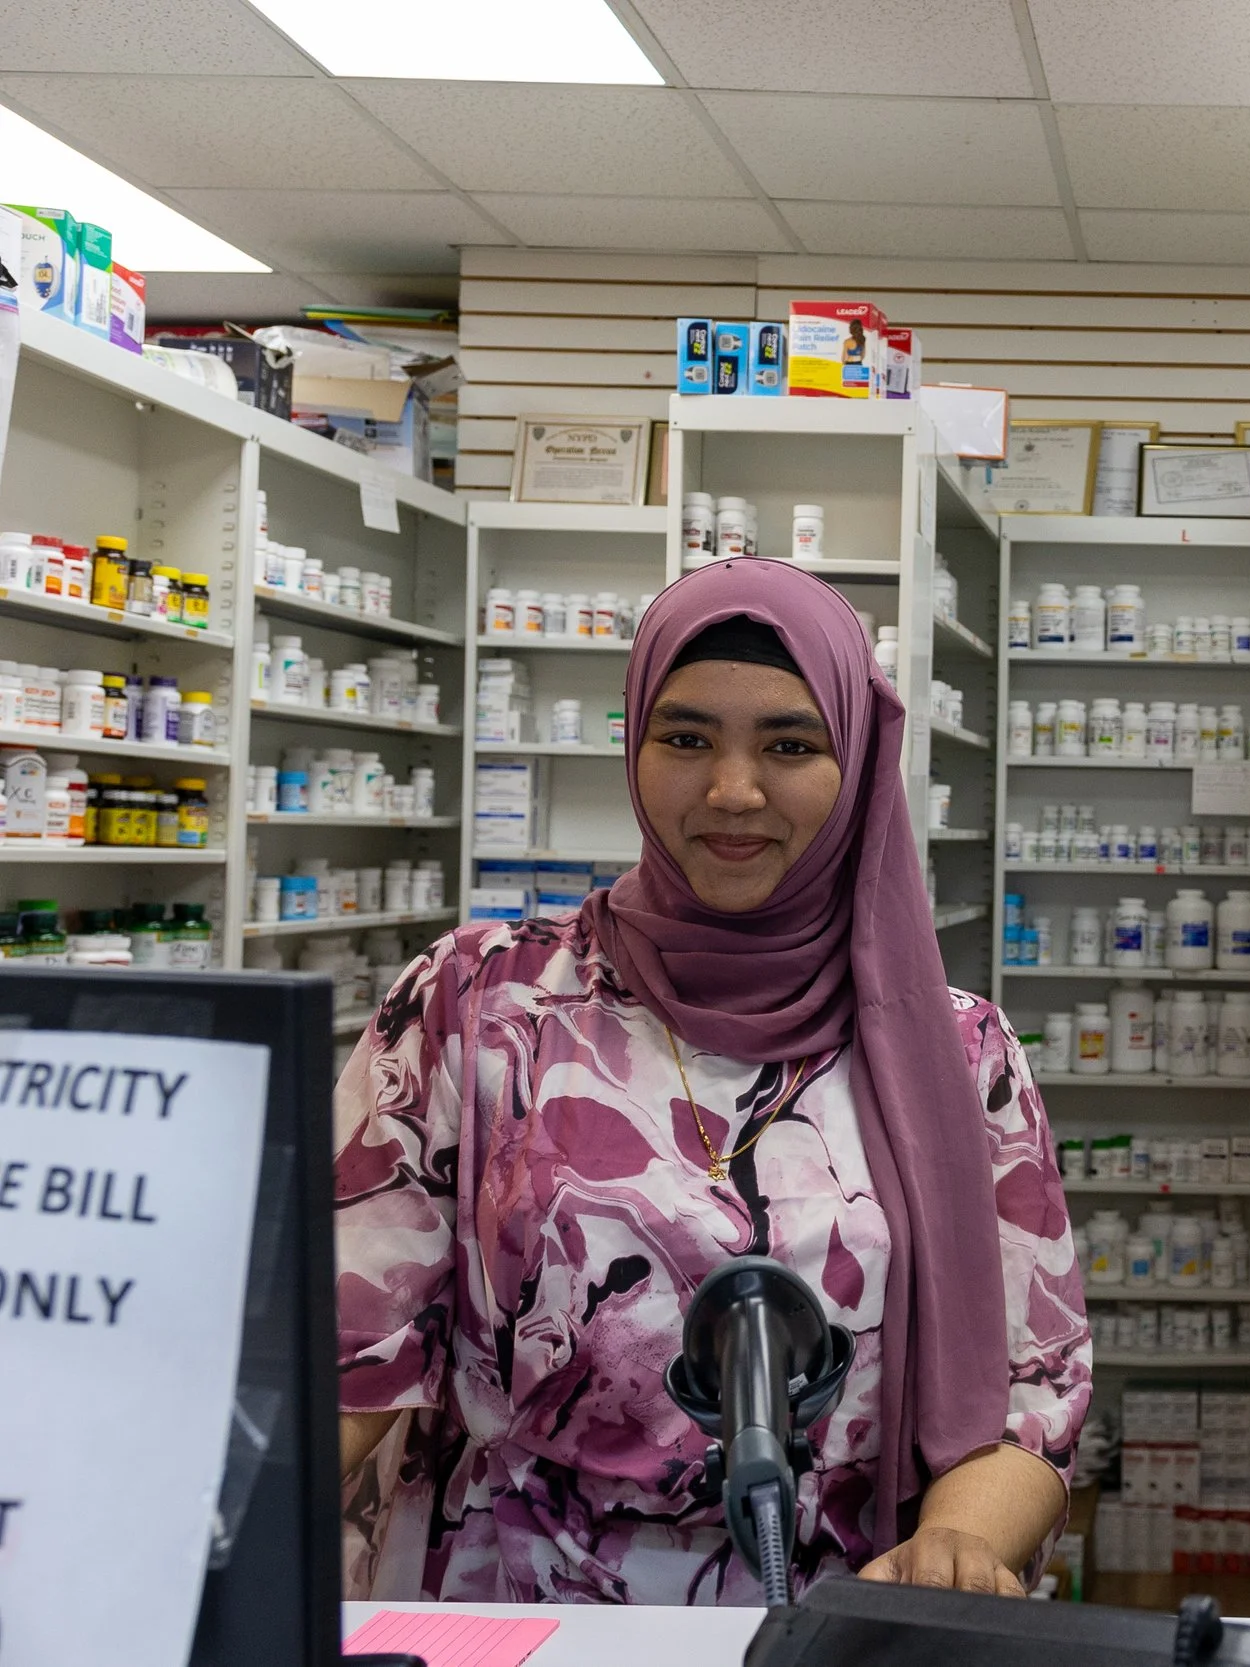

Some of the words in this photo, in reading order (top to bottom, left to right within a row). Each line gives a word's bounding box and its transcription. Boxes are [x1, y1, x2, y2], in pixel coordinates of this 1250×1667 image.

[1182, 529, 1190, 542] L
[0, 1059, 189, 1119] TRICITY
[41, 1165, 158, 1224] BILL
